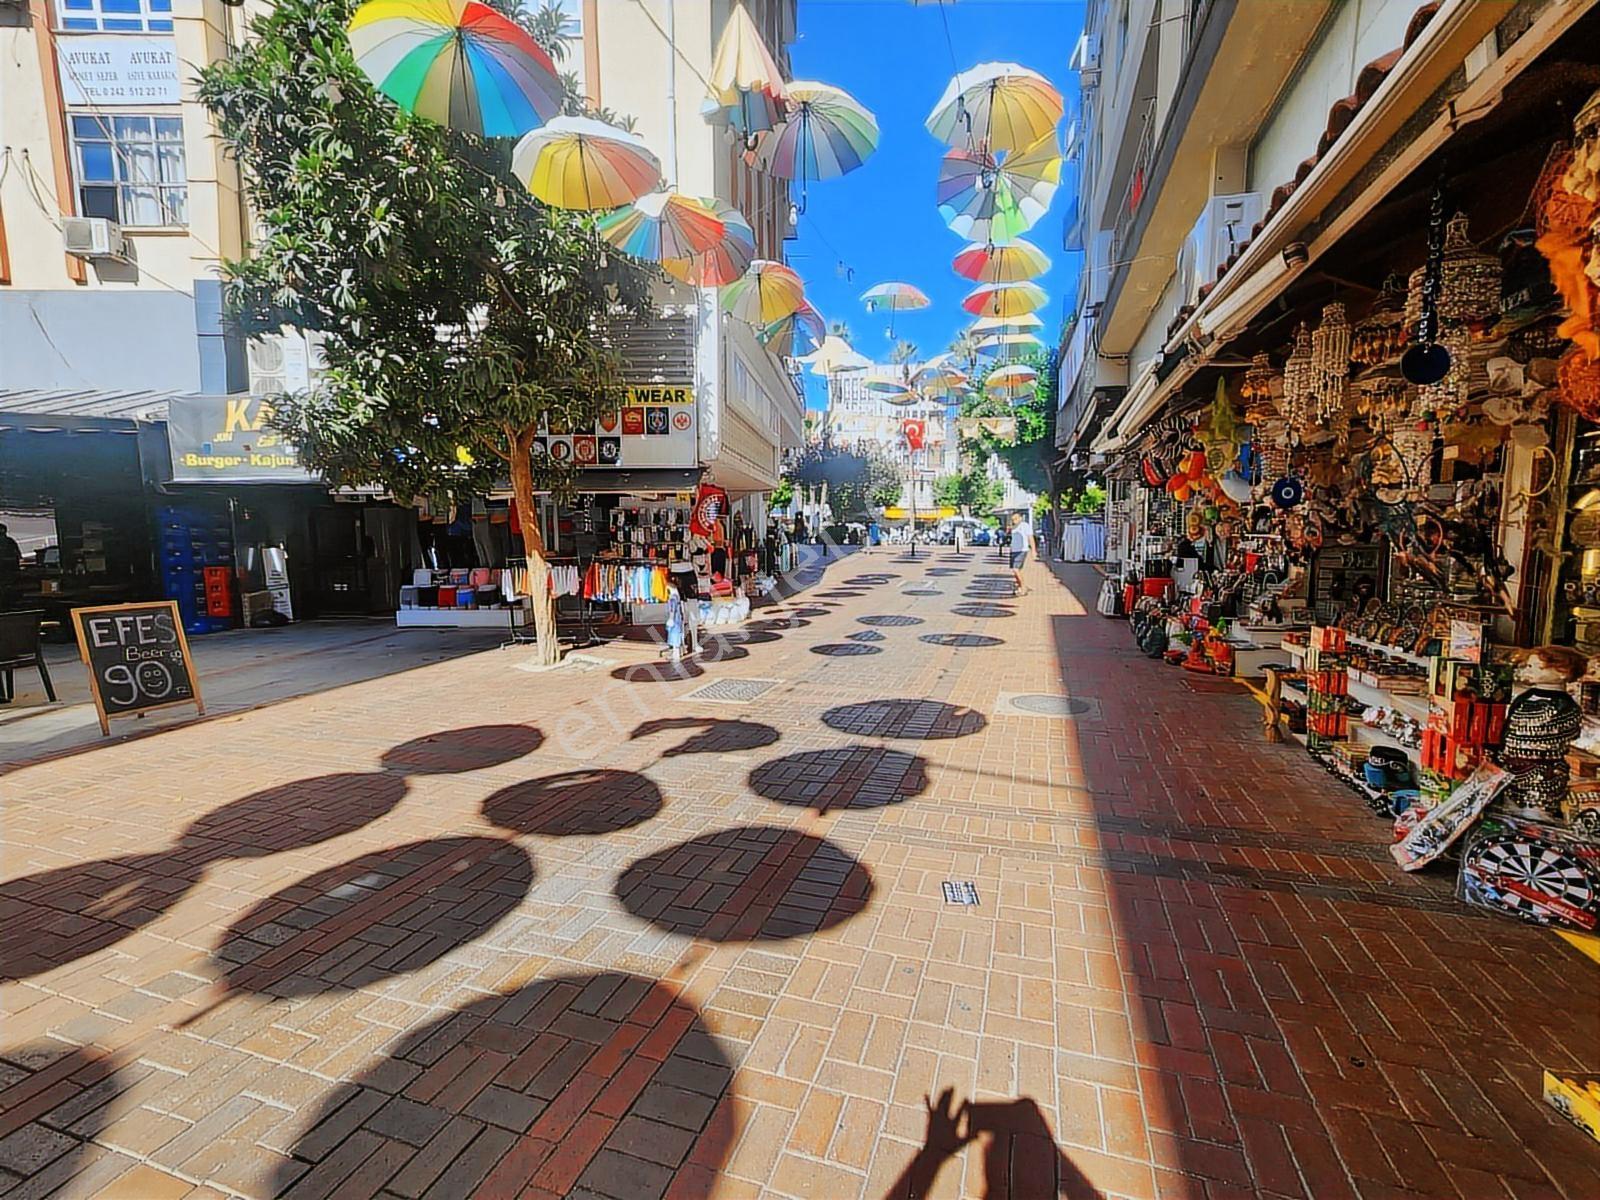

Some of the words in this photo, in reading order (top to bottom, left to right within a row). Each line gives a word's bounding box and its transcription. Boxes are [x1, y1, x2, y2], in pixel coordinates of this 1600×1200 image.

[68, 51, 112, 65] AVUKAT
[129, 51, 173, 65] AVUKAT
[634, 389, 687, 403] WEAR
[89, 614, 177, 648] EFES
[126, 646, 166, 661] Beer
